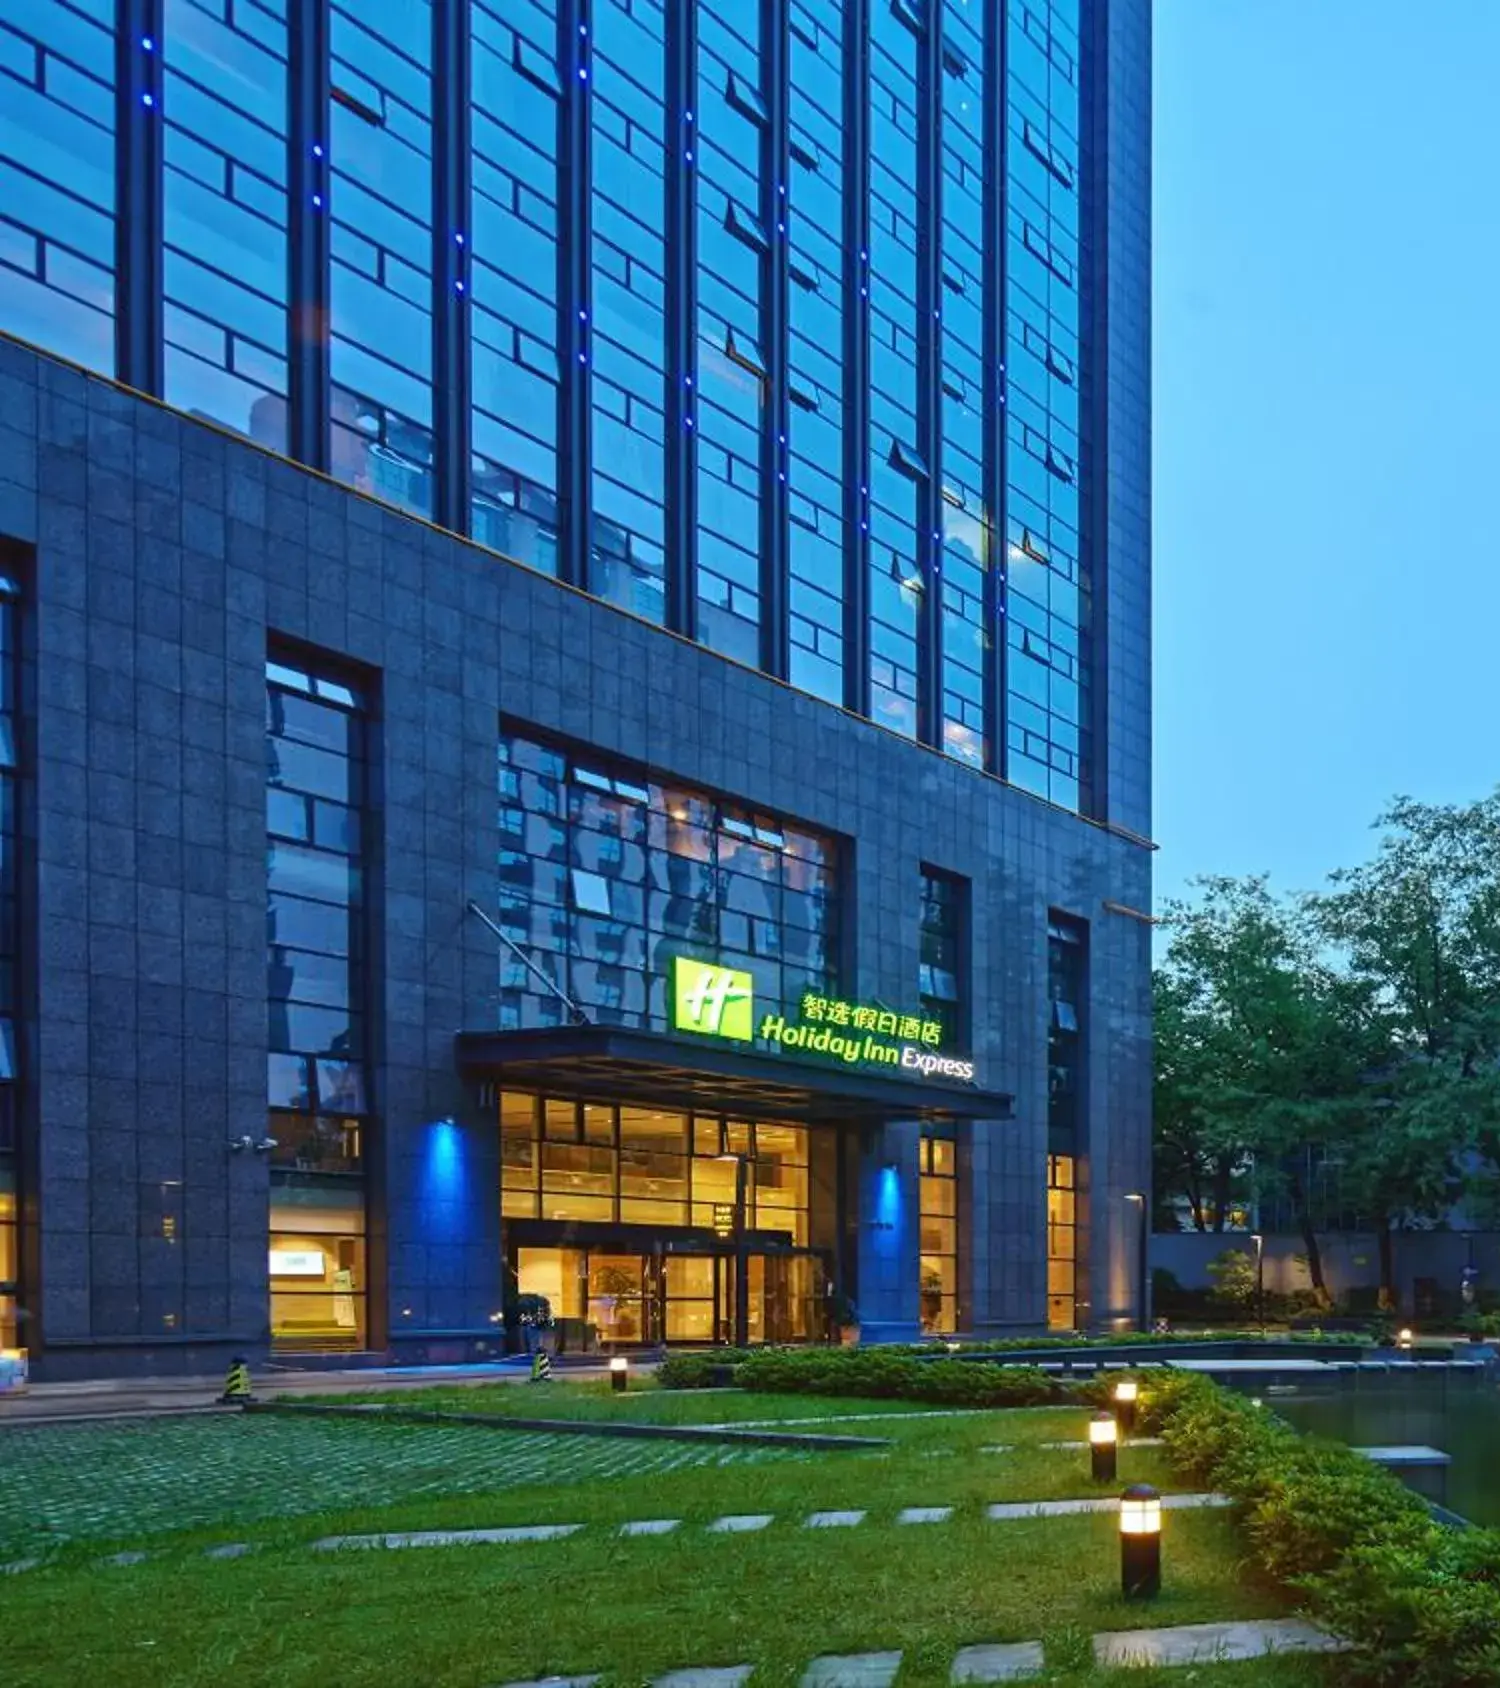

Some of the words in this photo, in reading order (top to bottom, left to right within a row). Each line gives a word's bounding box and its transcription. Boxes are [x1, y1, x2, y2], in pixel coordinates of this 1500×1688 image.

[762, 1014, 861, 1063] Holiday
[863, 1035, 899, 1064] Inn
[901, 1046, 974, 1080] Express
[803, 993, 942, 1045] 智选假日酒店
